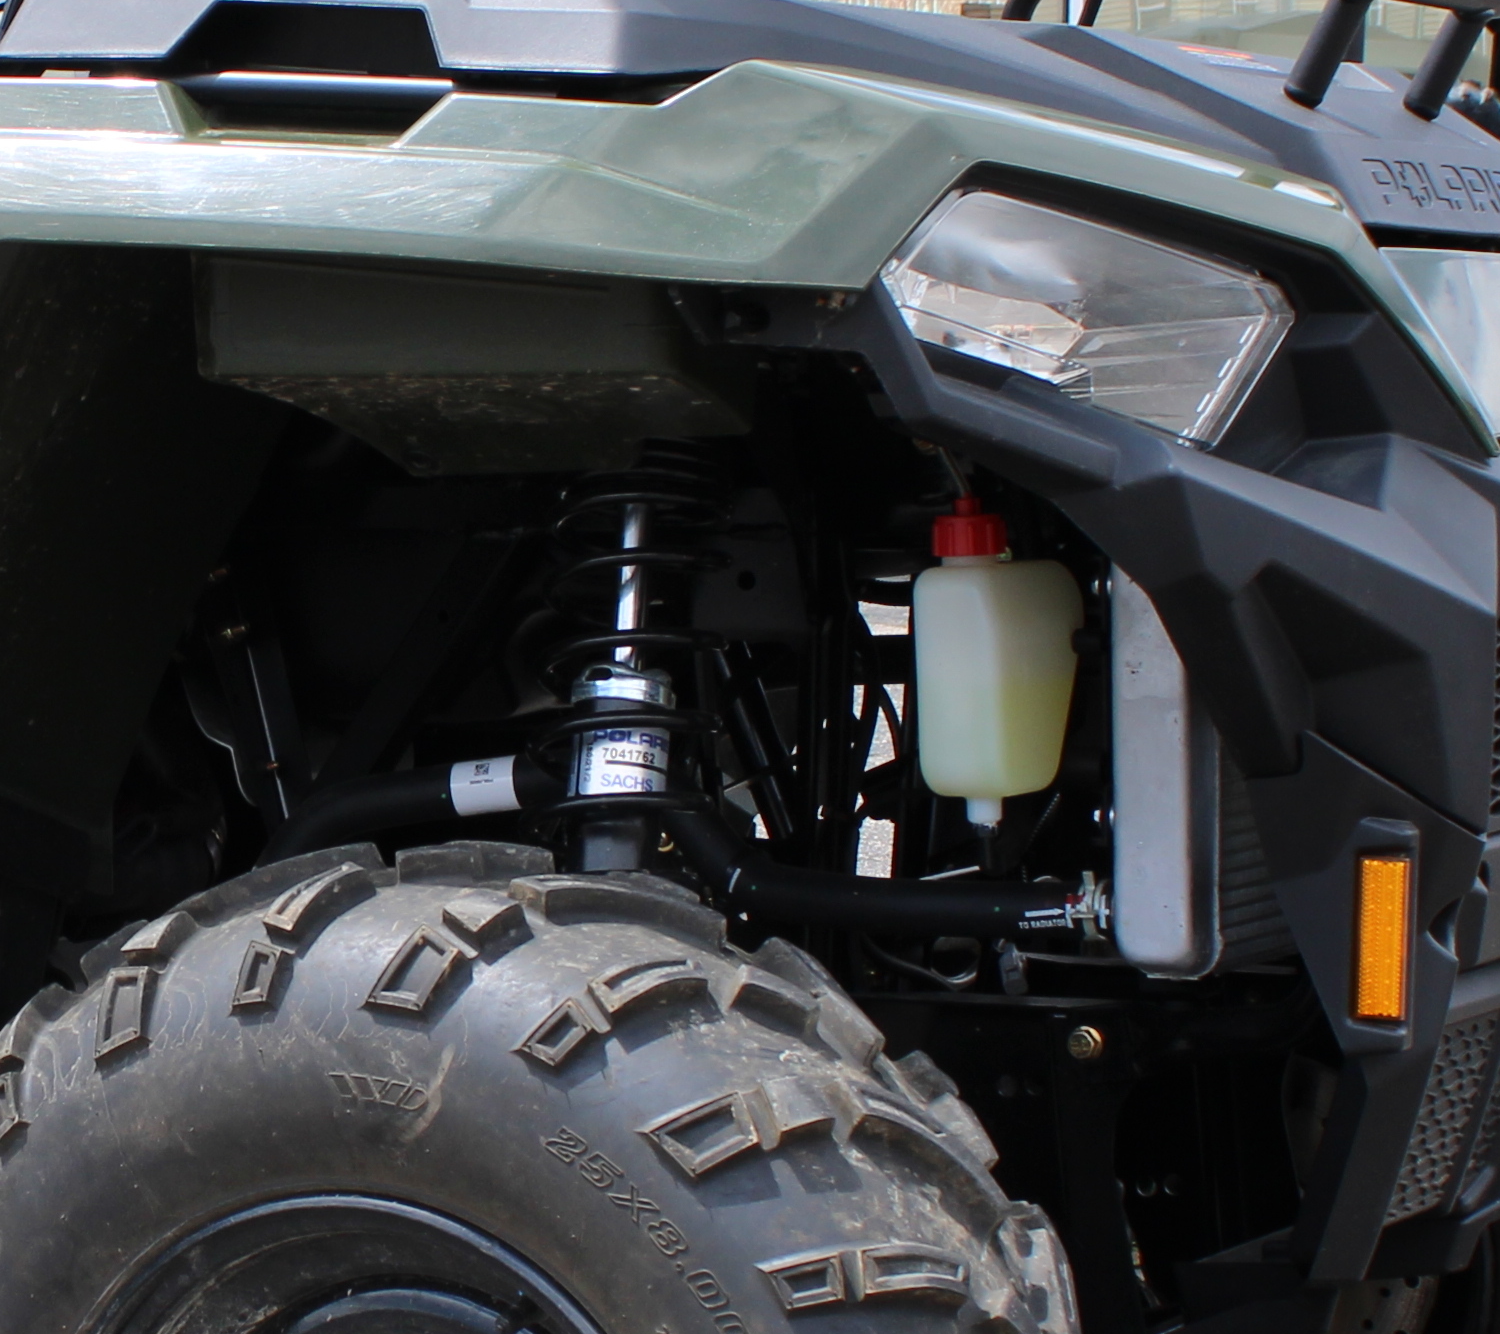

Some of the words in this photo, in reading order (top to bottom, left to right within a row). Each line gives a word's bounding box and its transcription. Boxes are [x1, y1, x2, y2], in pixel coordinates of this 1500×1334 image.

[601, 747, 656, 765] 7041762
[600, 772, 655, 793] SACHS
[1018, 920, 1029, 929] TO
[1030, 918, 1067, 929] RADIATOR
